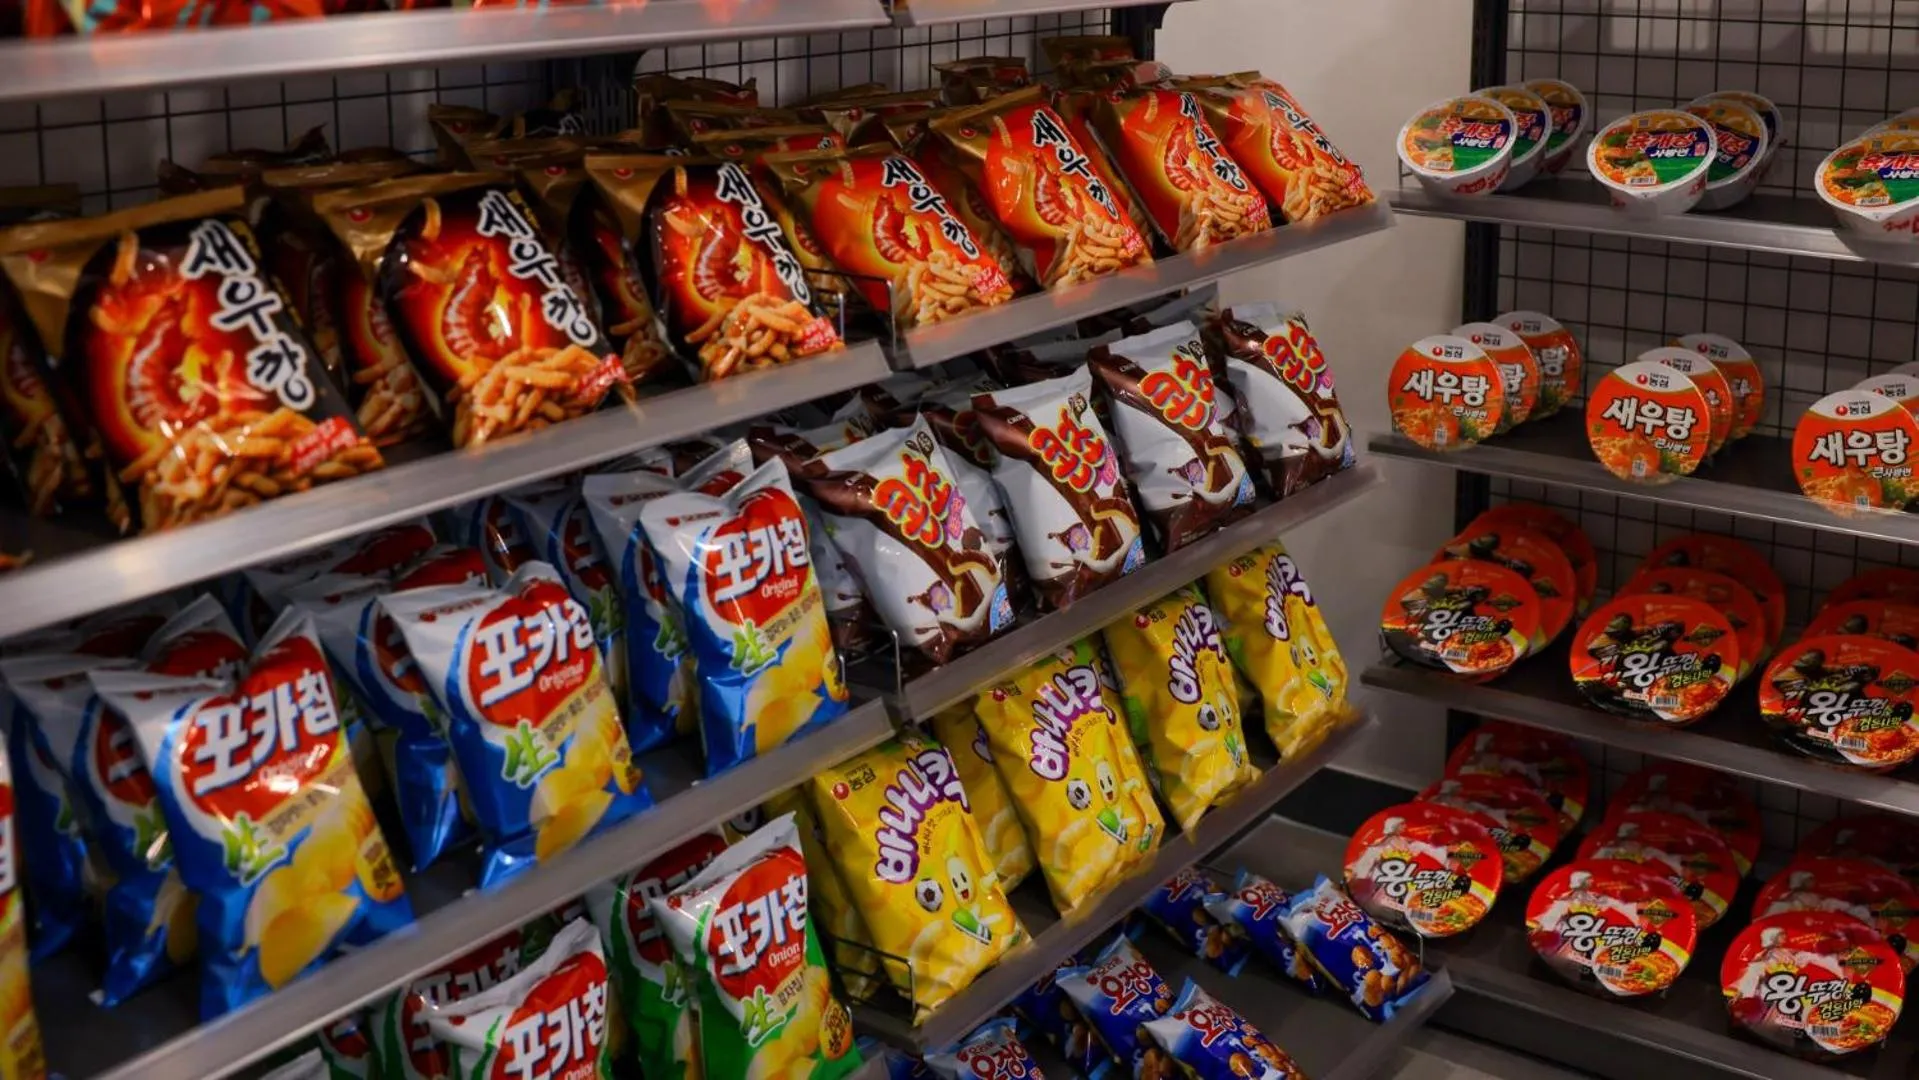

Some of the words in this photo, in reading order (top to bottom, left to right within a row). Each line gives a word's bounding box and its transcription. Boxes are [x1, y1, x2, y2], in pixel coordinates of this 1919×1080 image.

[1032, 109, 1121, 219] 새우깡
[1179, 91, 1248, 192] 새우깡
[717, 161, 811, 304] 새우깡
[881, 155, 980, 260] 새우깡
[180, 220, 314, 411] 새우깡
[477, 190, 597, 347] 새우깡
[1401, 368, 1491, 408] 새우탕
[1602, 395, 1699, 440] 새우탕
[1028, 407, 1105, 494] 콘초
[1808, 427, 1911, 467] 새우탕
[871, 452, 951, 549] 콘초
[714, 516, 808, 603] 포카칩
[761, 575, 799, 599] Original
[476, 598, 594, 708] 포카칩
[538, 657, 585, 693] Original
[1167, 602, 1226, 705] 바나나킥
[193, 668, 340, 797] 포카칩
[501, 718, 562, 791] 生
[852, 768, 877, 791] 농심
[874, 746, 972, 885] 바나나킥
[714, 873, 808, 977] 포카칩
[768, 942, 801, 968] Onion
[503, 981, 608, 1080] 포카칩
